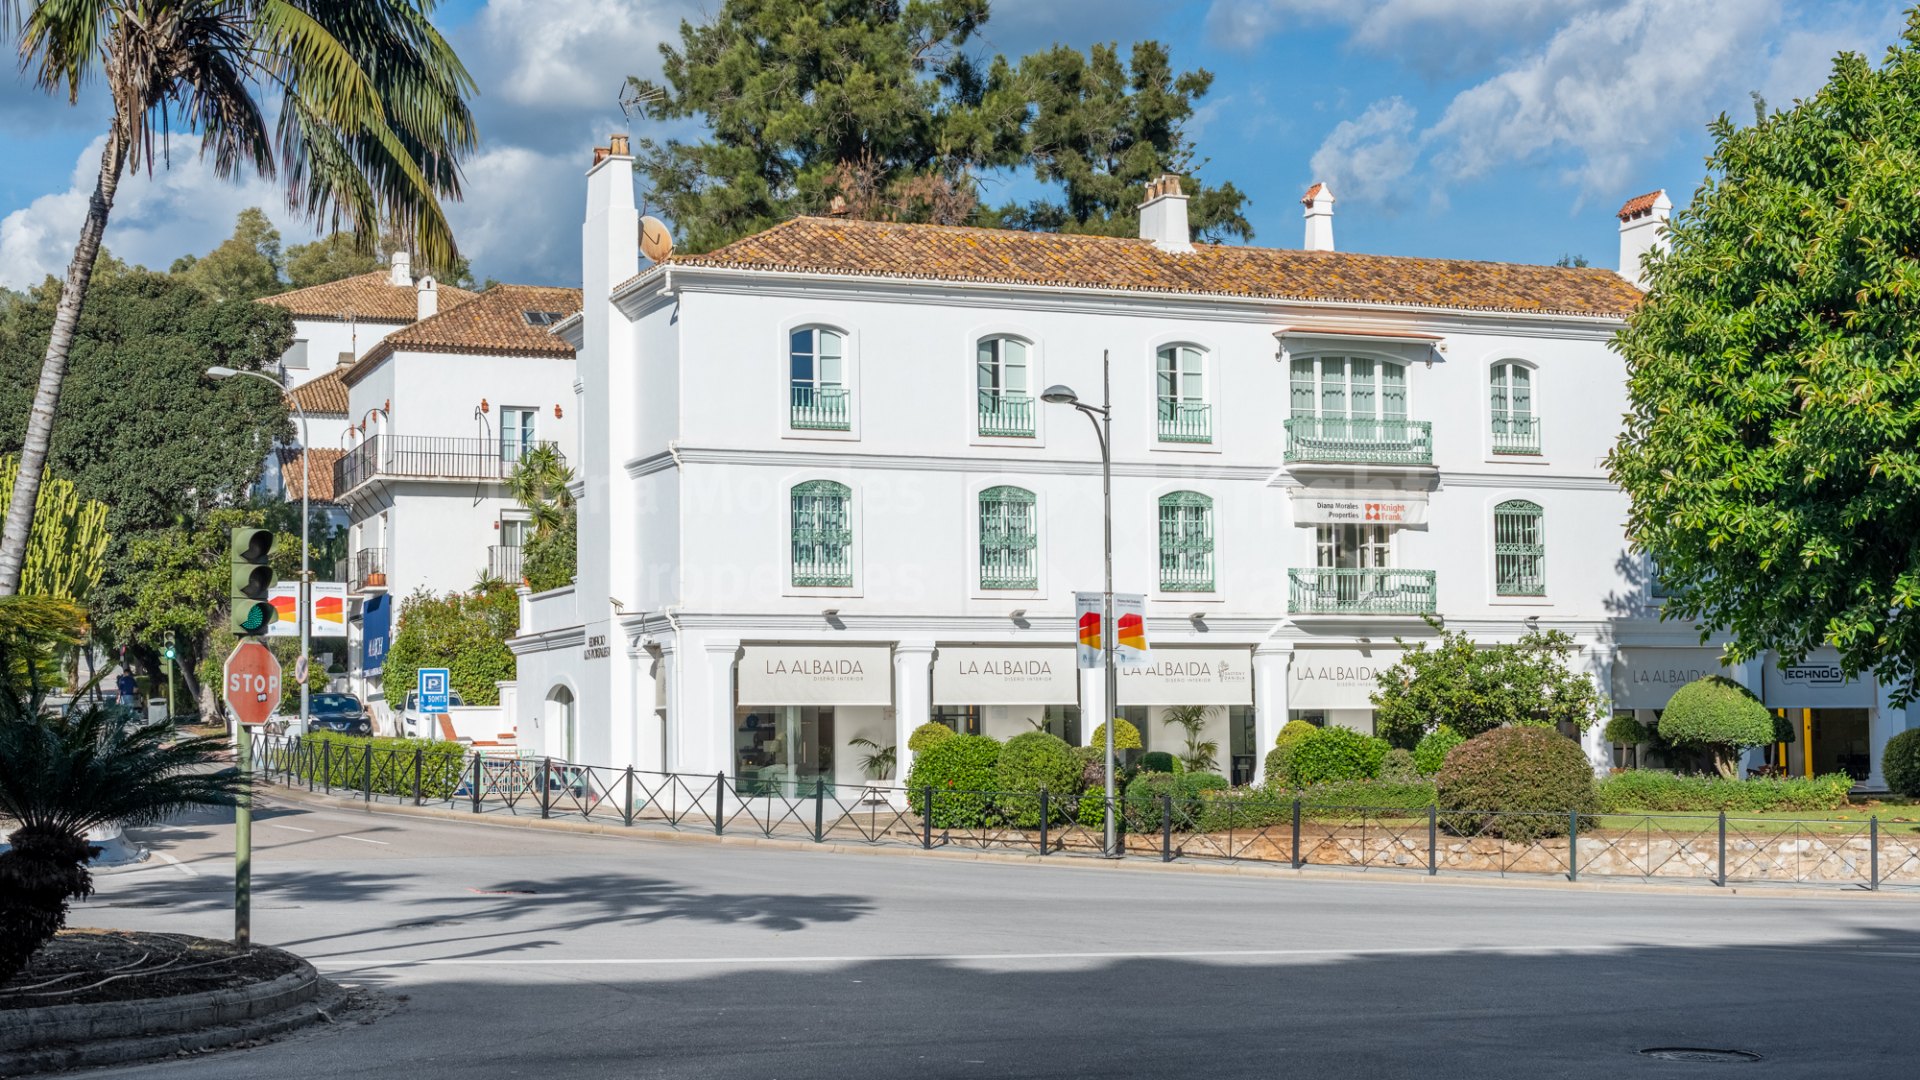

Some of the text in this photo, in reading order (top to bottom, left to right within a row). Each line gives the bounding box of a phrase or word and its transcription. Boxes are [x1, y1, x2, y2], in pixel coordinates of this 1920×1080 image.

[1381, 504, 1405, 513] Knight
[1328, 512, 1359, 520] Properties
[766, 660, 864, 674] LA ALBAIDA
[960, 660, 1052, 674] LA ALBAIDA
[1146, 662, 1211, 676] ALBAIDA
[1297, 667, 1314, 680] LA
[1633, 670, 1649, 683] LA
[230, 673, 278, 694] STOP
[428, 678, 439, 689] P
